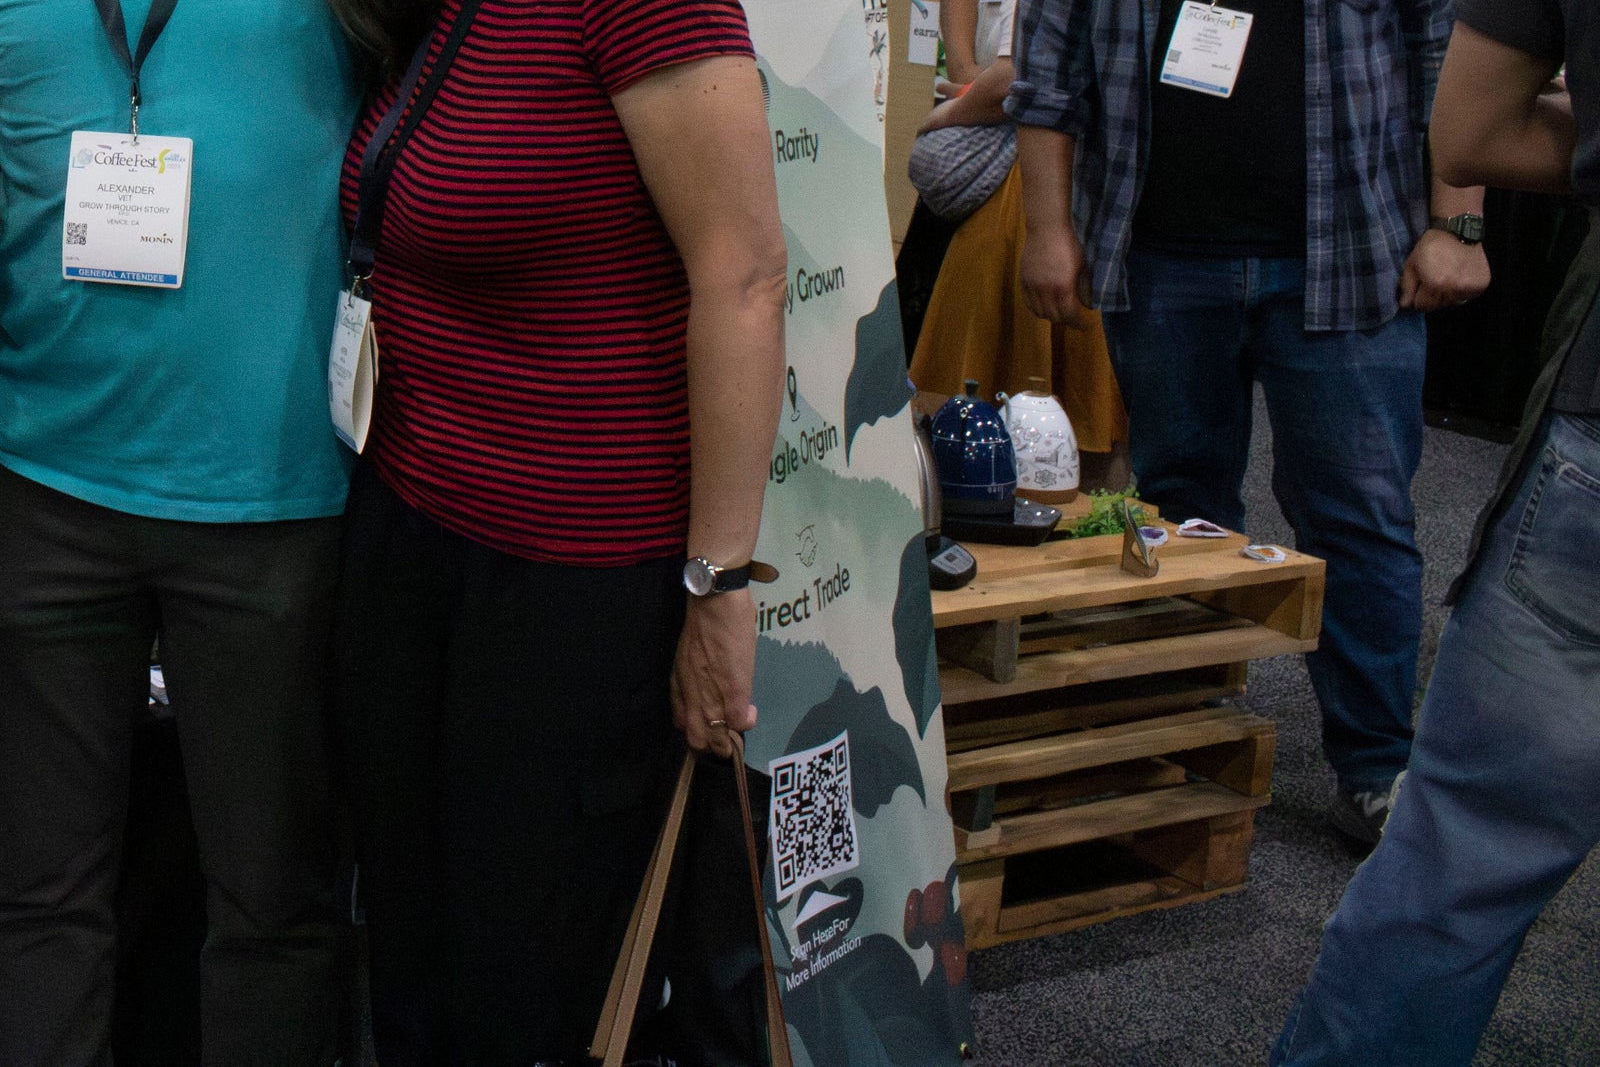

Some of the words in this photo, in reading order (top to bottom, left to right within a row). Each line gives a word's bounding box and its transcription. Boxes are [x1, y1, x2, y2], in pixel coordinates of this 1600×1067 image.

[775, 128, 819, 164] Rarity
[97, 183, 156, 195] ALEXANDER
[144, 206, 170, 214] STORY
[78, 268, 118, 279] GENERAL
[120, 272, 165, 283] ATTENDEE
[797, 265, 845, 302] Grown
[800, 421, 838, 465] Origin
[756, 589, 811, 633] irect
[813, 562, 851, 612] Trade
[785, 968, 810, 992] More
[809, 936, 862, 976] Information
